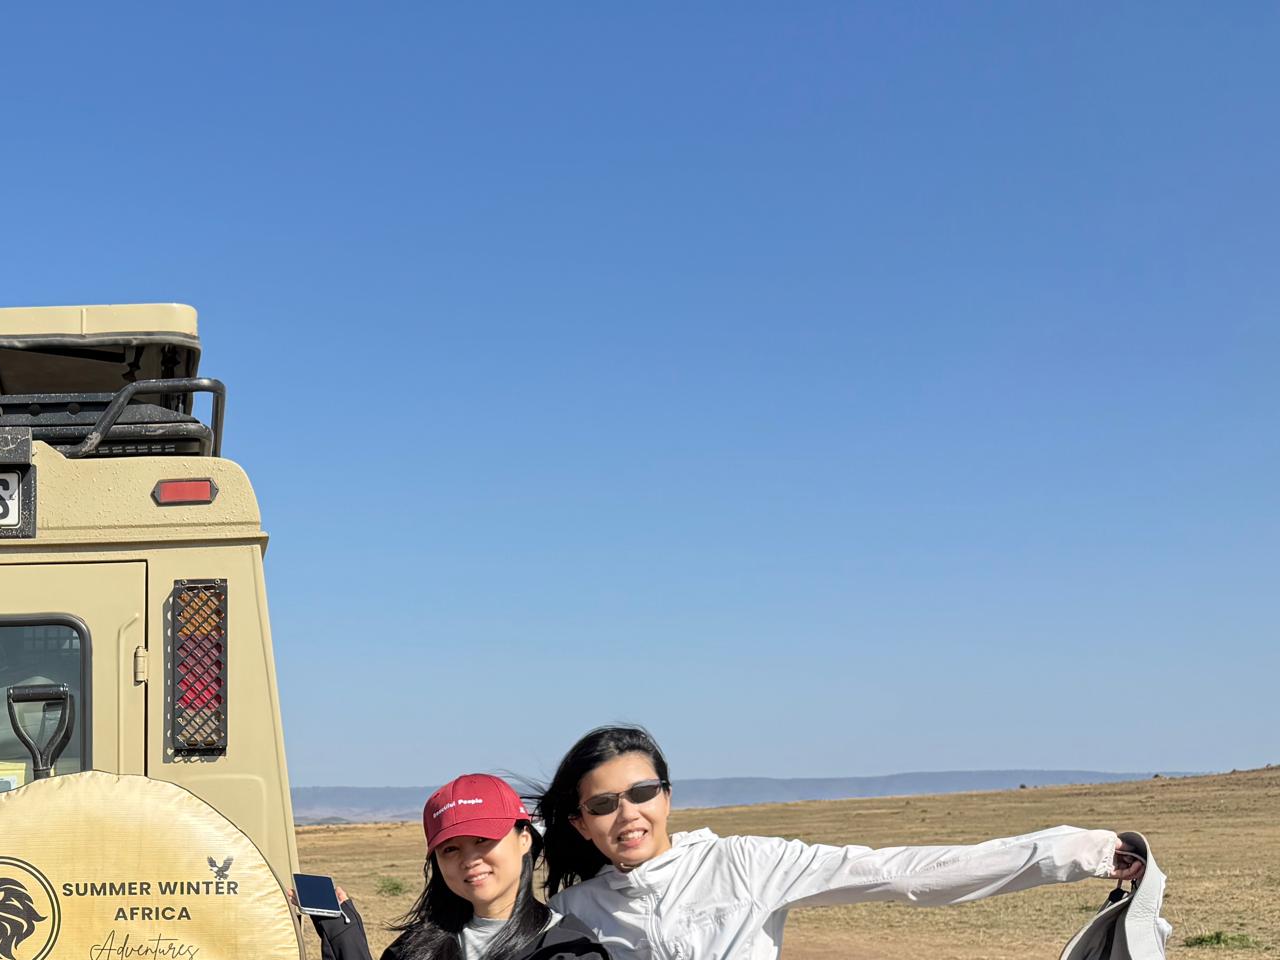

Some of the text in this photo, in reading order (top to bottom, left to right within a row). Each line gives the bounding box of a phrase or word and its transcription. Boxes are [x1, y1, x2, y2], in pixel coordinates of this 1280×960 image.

[62, 881, 239, 897] SUMMER WINTER
[114, 906, 192, 921] AFRICA
